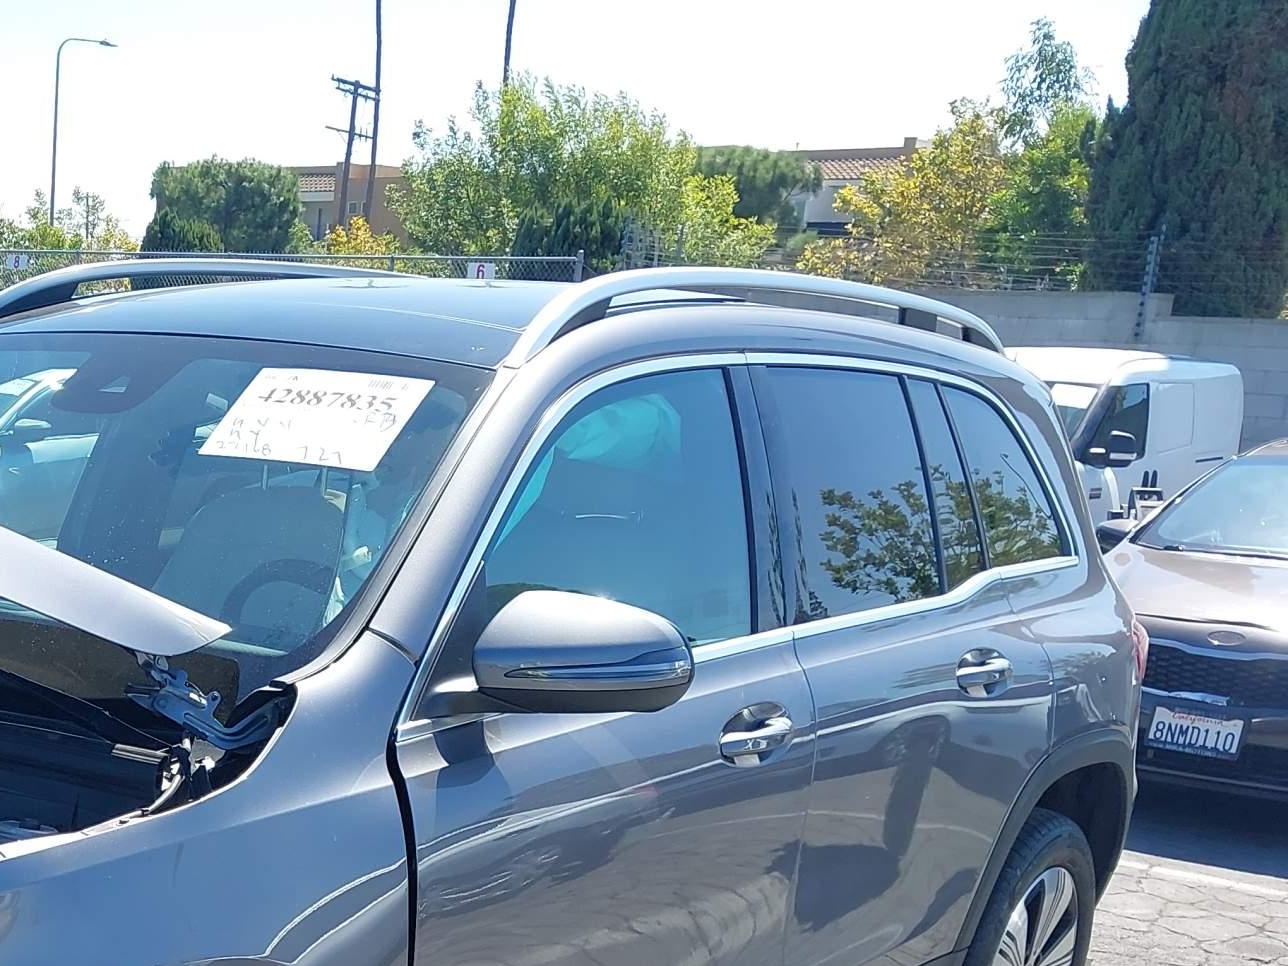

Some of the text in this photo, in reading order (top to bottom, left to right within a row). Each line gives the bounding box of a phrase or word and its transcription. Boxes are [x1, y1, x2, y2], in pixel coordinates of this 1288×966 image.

[13, 255, 21, 269] 8
[477, 264, 485, 279] 6
[258, 388, 398, 412] 42887835
[1153, 720, 1236, 753] 8NMD110
